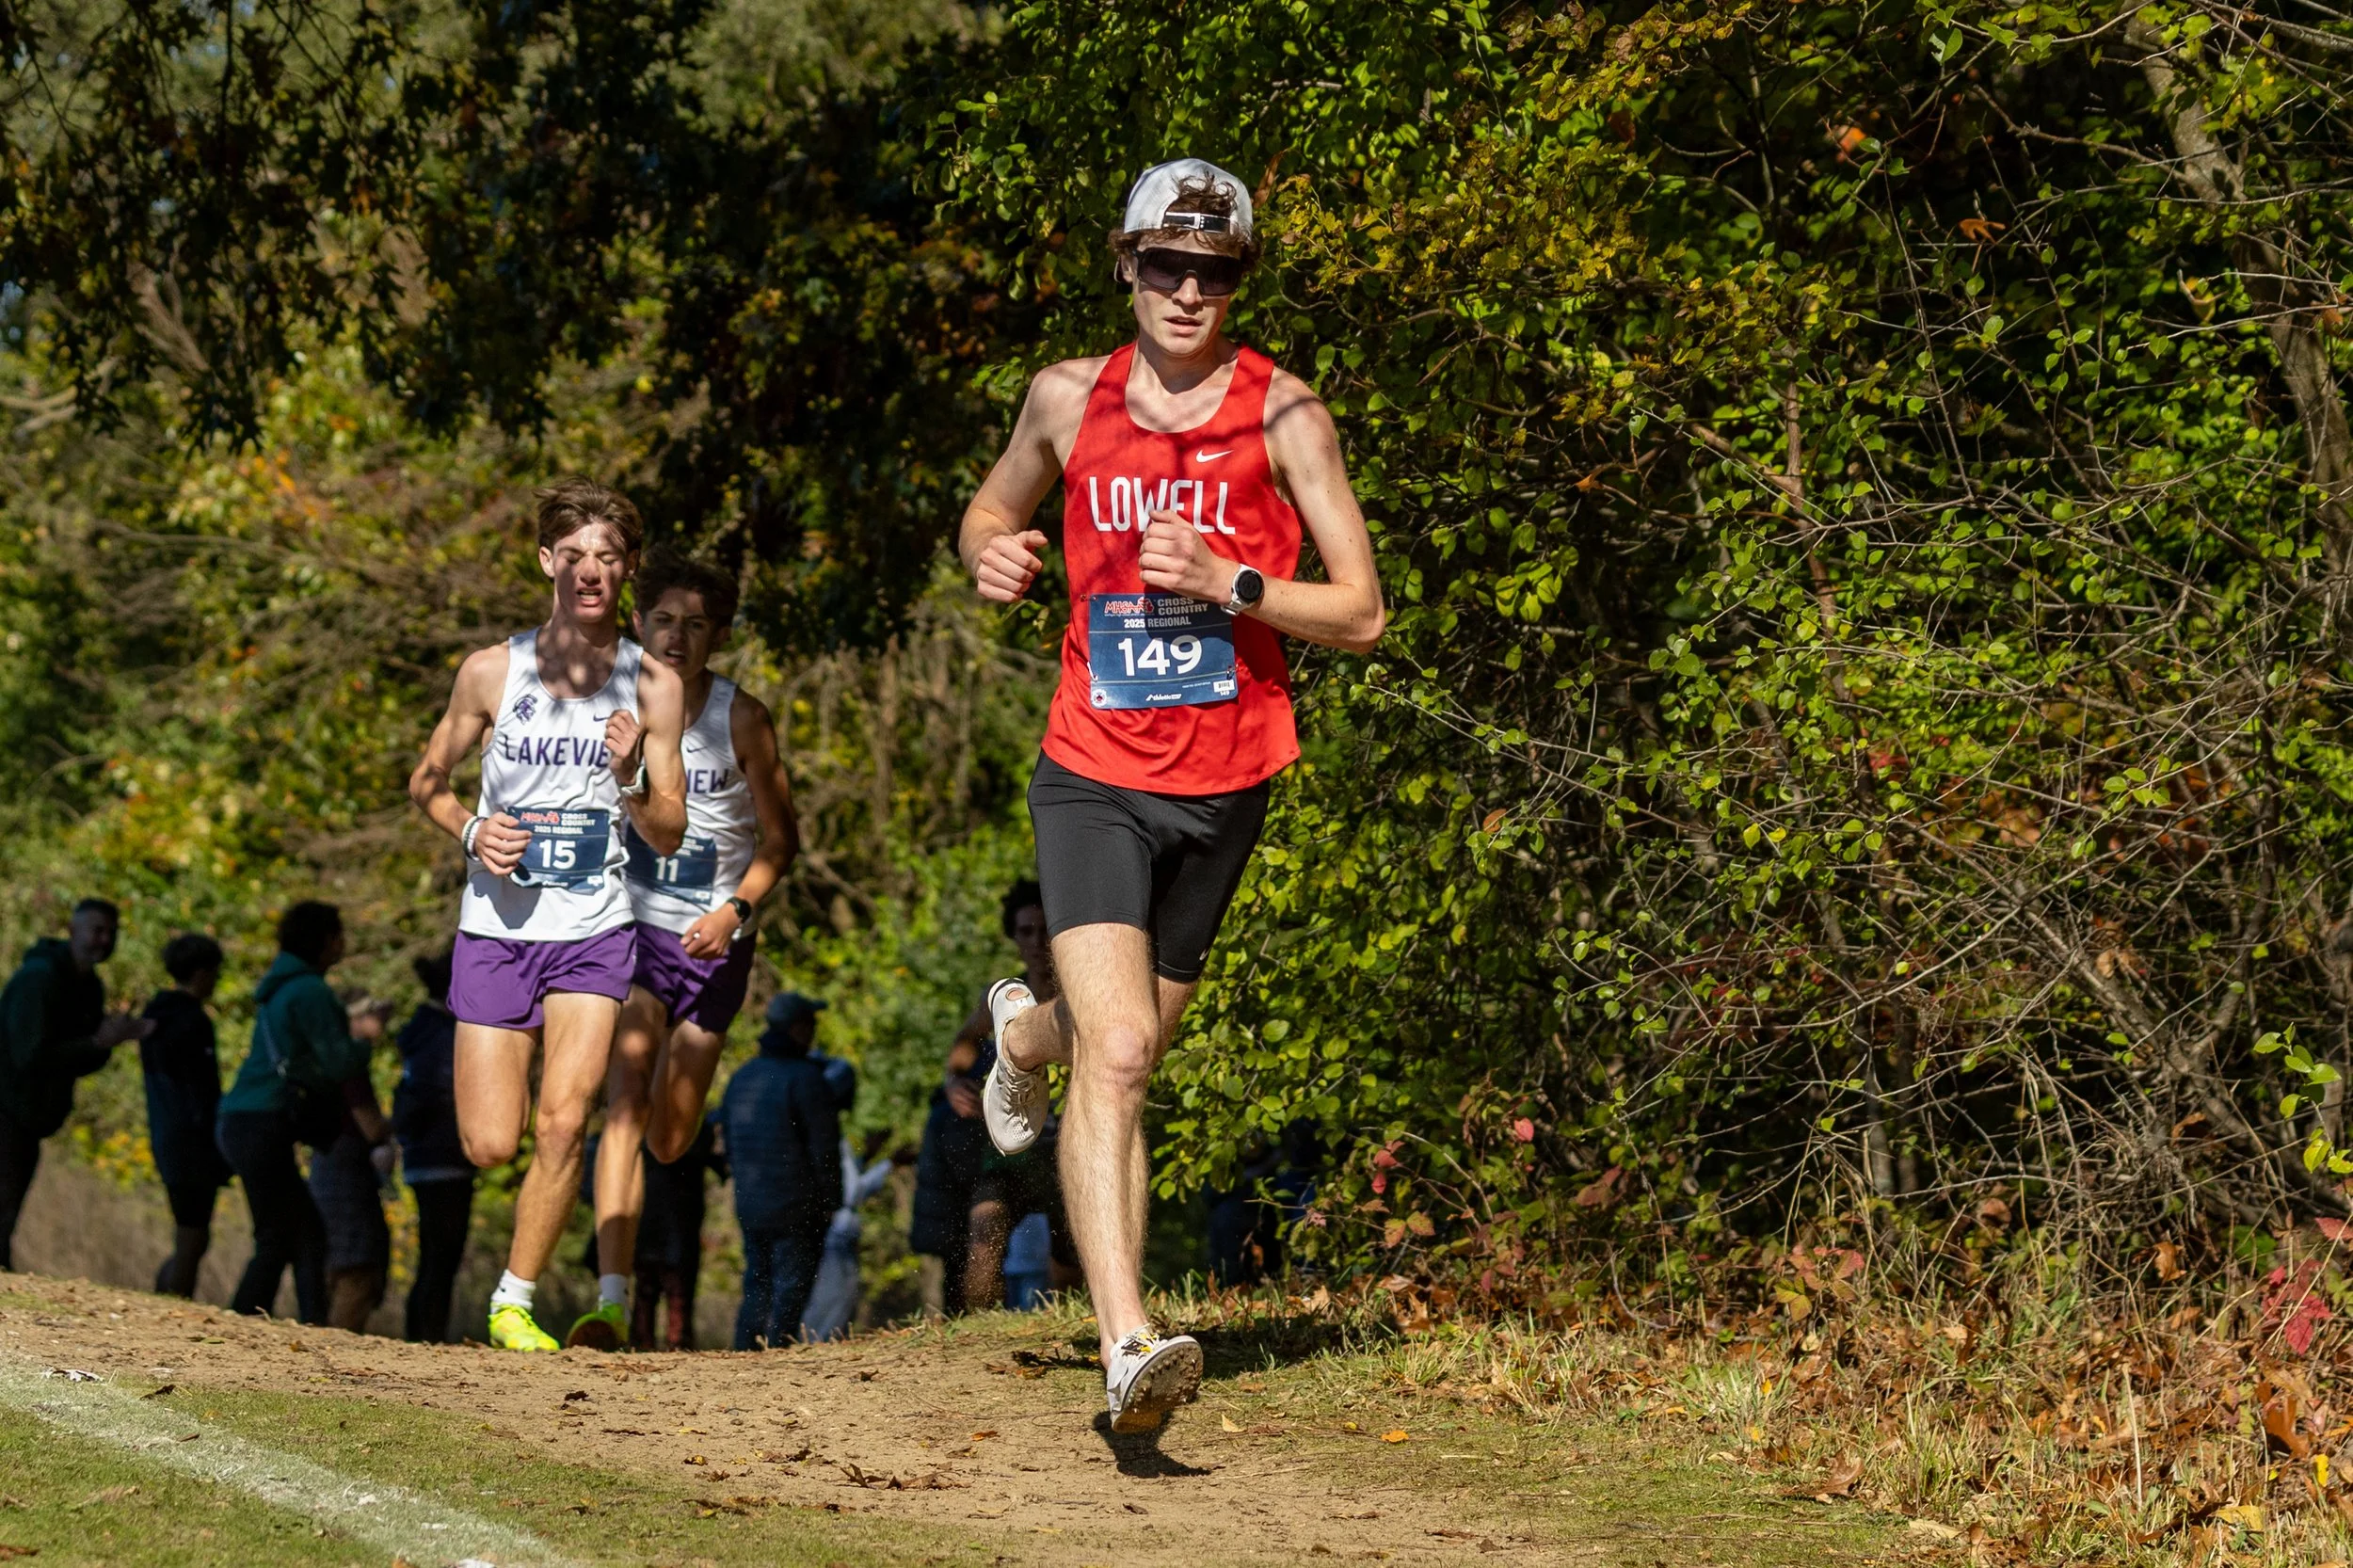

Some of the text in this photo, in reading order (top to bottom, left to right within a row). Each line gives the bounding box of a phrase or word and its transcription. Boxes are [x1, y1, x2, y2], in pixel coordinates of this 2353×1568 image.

[1088, 475, 1236, 536] LOWELL
[1157, 597, 1194, 608] CROSS
[1158, 602, 1209, 616] COUNTRY
[1124, 616, 1192, 629] 2025 REGIONAL
[1117, 634, 1203, 677] 149
[504, 733, 610, 769] LAKEVIE
[538, 839, 578, 871] 15
[654, 856, 680, 883] 11
